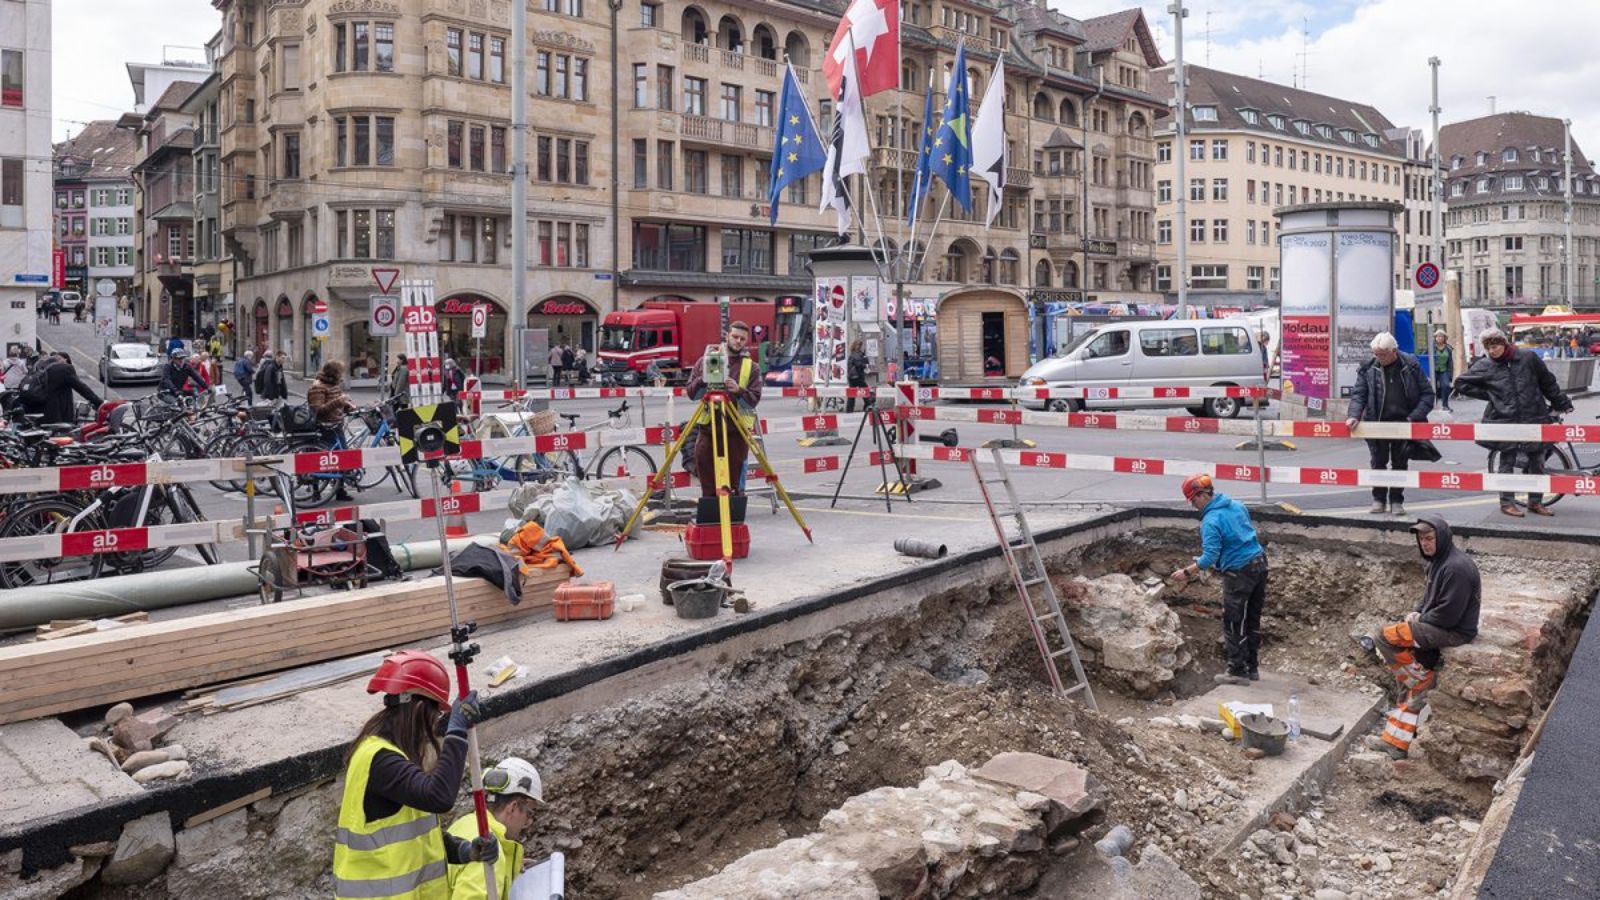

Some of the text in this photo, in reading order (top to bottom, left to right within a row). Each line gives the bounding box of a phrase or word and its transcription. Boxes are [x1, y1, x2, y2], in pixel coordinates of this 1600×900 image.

[380, 311, 390, 321] 30
[408, 308, 433, 325] ab
[1283, 324, 1329, 333] Moldau
[1166, 388, 1177, 396] ab
[1239, 388, 1250, 396] ab
[909, 406, 921, 417] ab
[993, 409, 1006, 420] ab
[815, 415, 826, 427] ab
[1084, 413, 1098, 425] ab
[1184, 417, 1199, 430] ab
[1314, 421, 1331, 433] ab
[1432, 423, 1451, 436] ab
[1565, 425, 1585, 437] ab
[553, 434, 568, 446] ab
[320, 452, 339, 466] ab
[1036, 453, 1049, 464] ab
[1131, 459, 1146, 471] ab
[90, 466, 115, 482] ab
[1235, 465, 1251, 478] ab
[1320, 468, 1337, 481] ab
[1441, 472, 1460, 485] ab
[1575, 477, 1596, 490] ab
[444, 497, 459, 510] ab
[93, 531, 118, 548] ab
